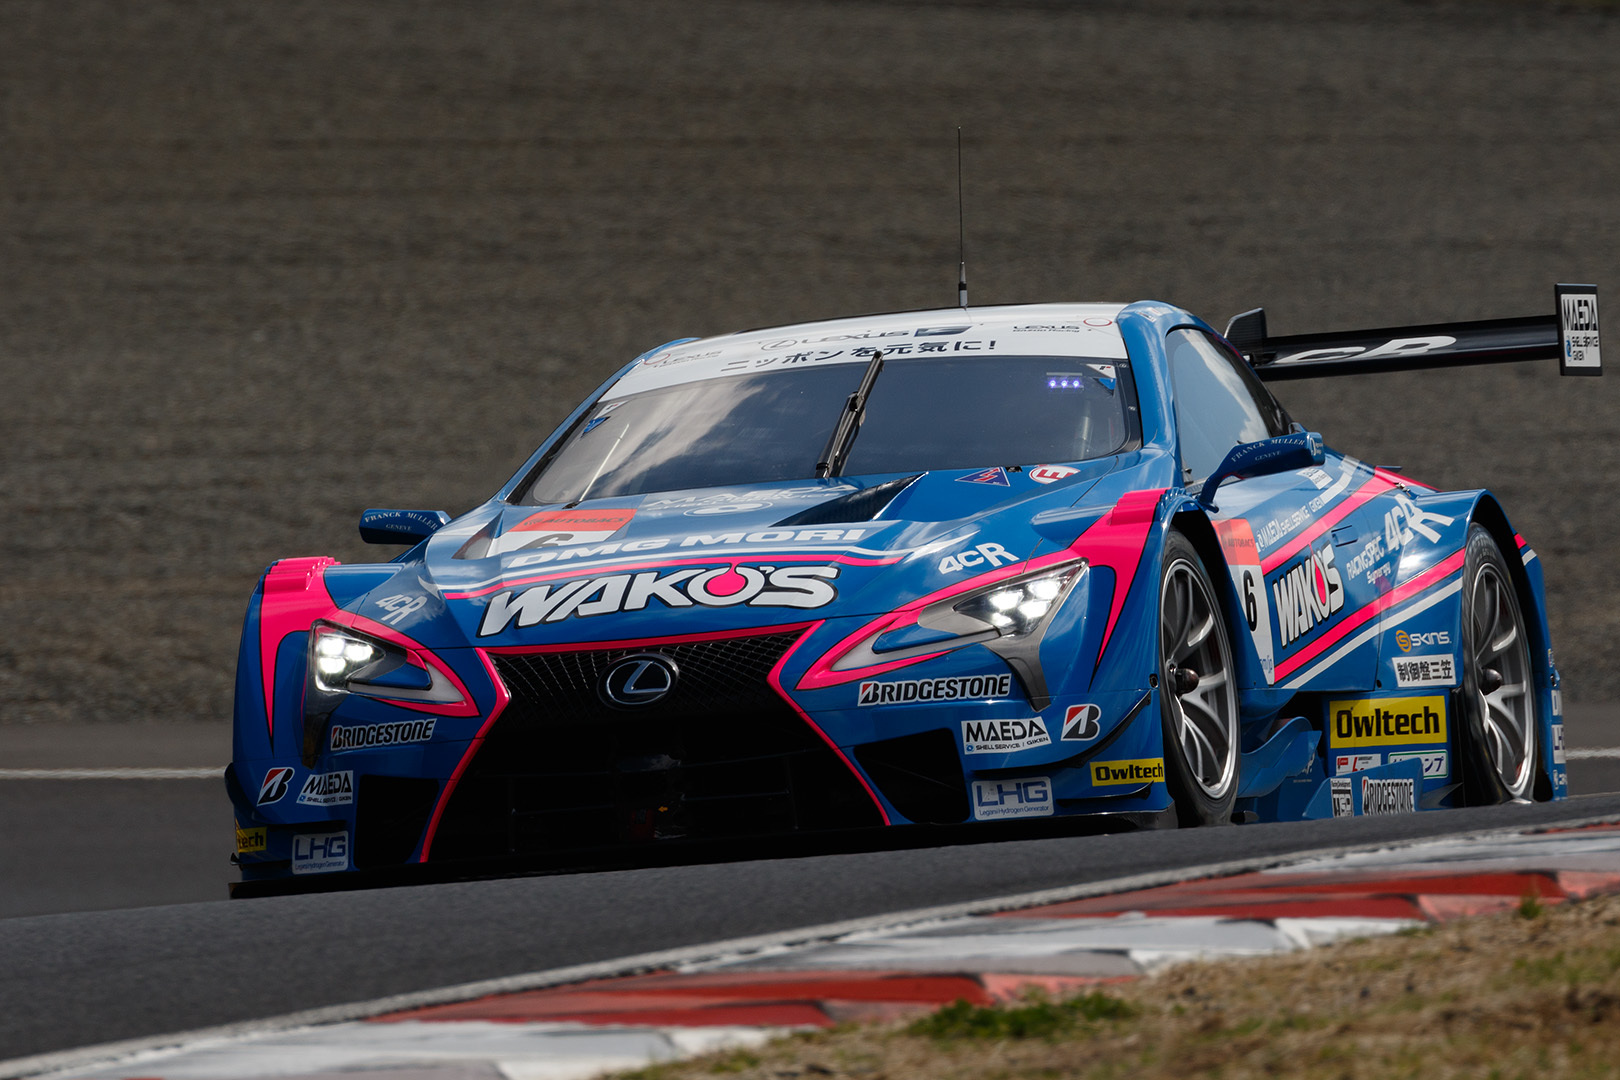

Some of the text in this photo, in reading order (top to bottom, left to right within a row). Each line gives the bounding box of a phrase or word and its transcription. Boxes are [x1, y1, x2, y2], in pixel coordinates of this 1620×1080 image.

[1562, 299, 1598, 331] MAEDA
[1231, 438, 1306, 463] FRANCK MULLER
[364, 511, 439, 531] FRANCK MULLER
[546, 515, 627, 525] AUTOBACS
[507, 528, 866, 569] DMG MORI
[938, 542, 1020, 575] 4CR
[375, 594, 428, 625] 4CR
[477, 565, 839, 638] WAKO'S
[1243, 569, 1258, 632] 6
[860, 674, 1011, 706] BRIDGESTONE
[331, 718, 437, 750] BRIDGESTONE
[966, 720, 1046, 742] MAEDA
[1336, 705, 1440, 739] Owltech
[303, 772, 352, 796] MAEDA
[1095, 763, 1163, 781] Owltech
[976, 781, 1048, 807] LHG
[1363, 777, 1413, 816] BRIDGESTONE
[295, 836, 346, 861] LHG
